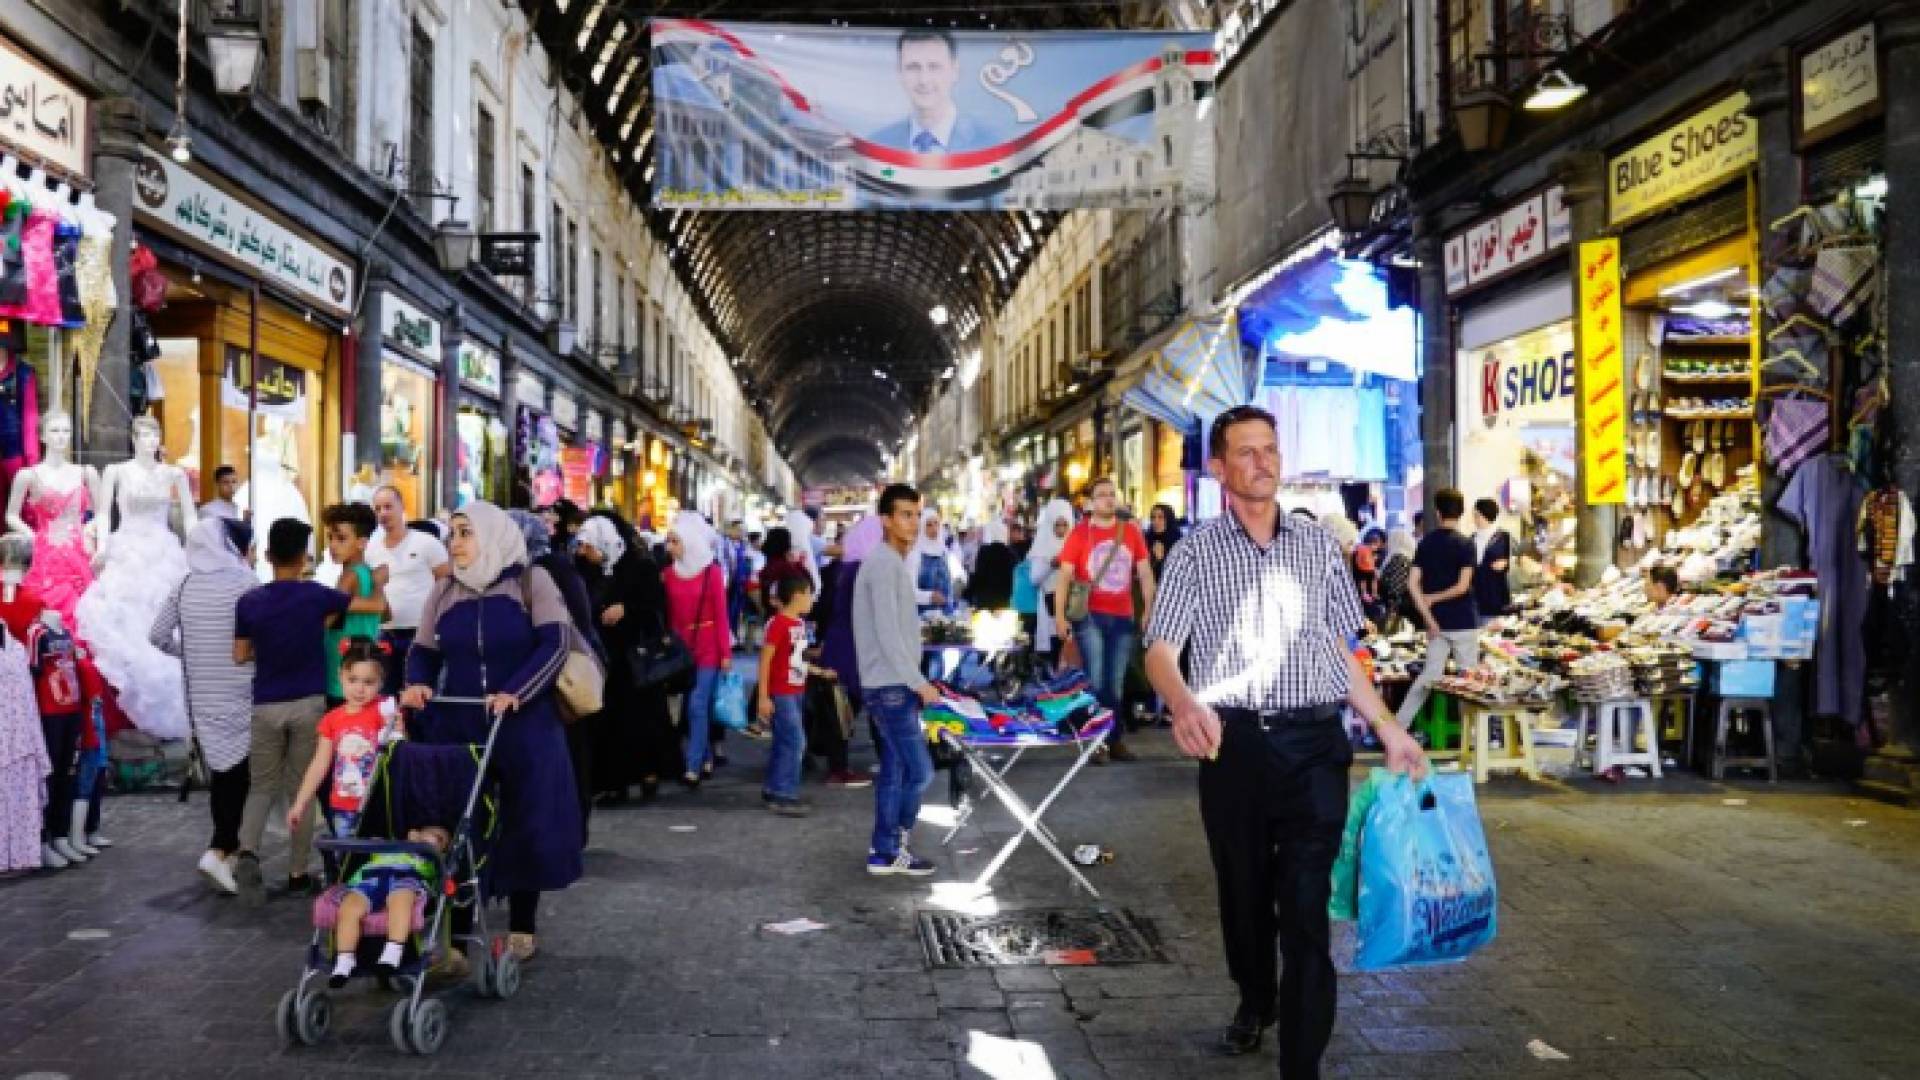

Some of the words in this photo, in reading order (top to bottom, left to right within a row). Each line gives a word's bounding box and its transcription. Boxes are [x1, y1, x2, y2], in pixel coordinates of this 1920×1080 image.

[1616, 150, 1664, 195] Blue
[1669, 110, 1748, 168] Shoes
[1481, 358, 1501, 417] K
